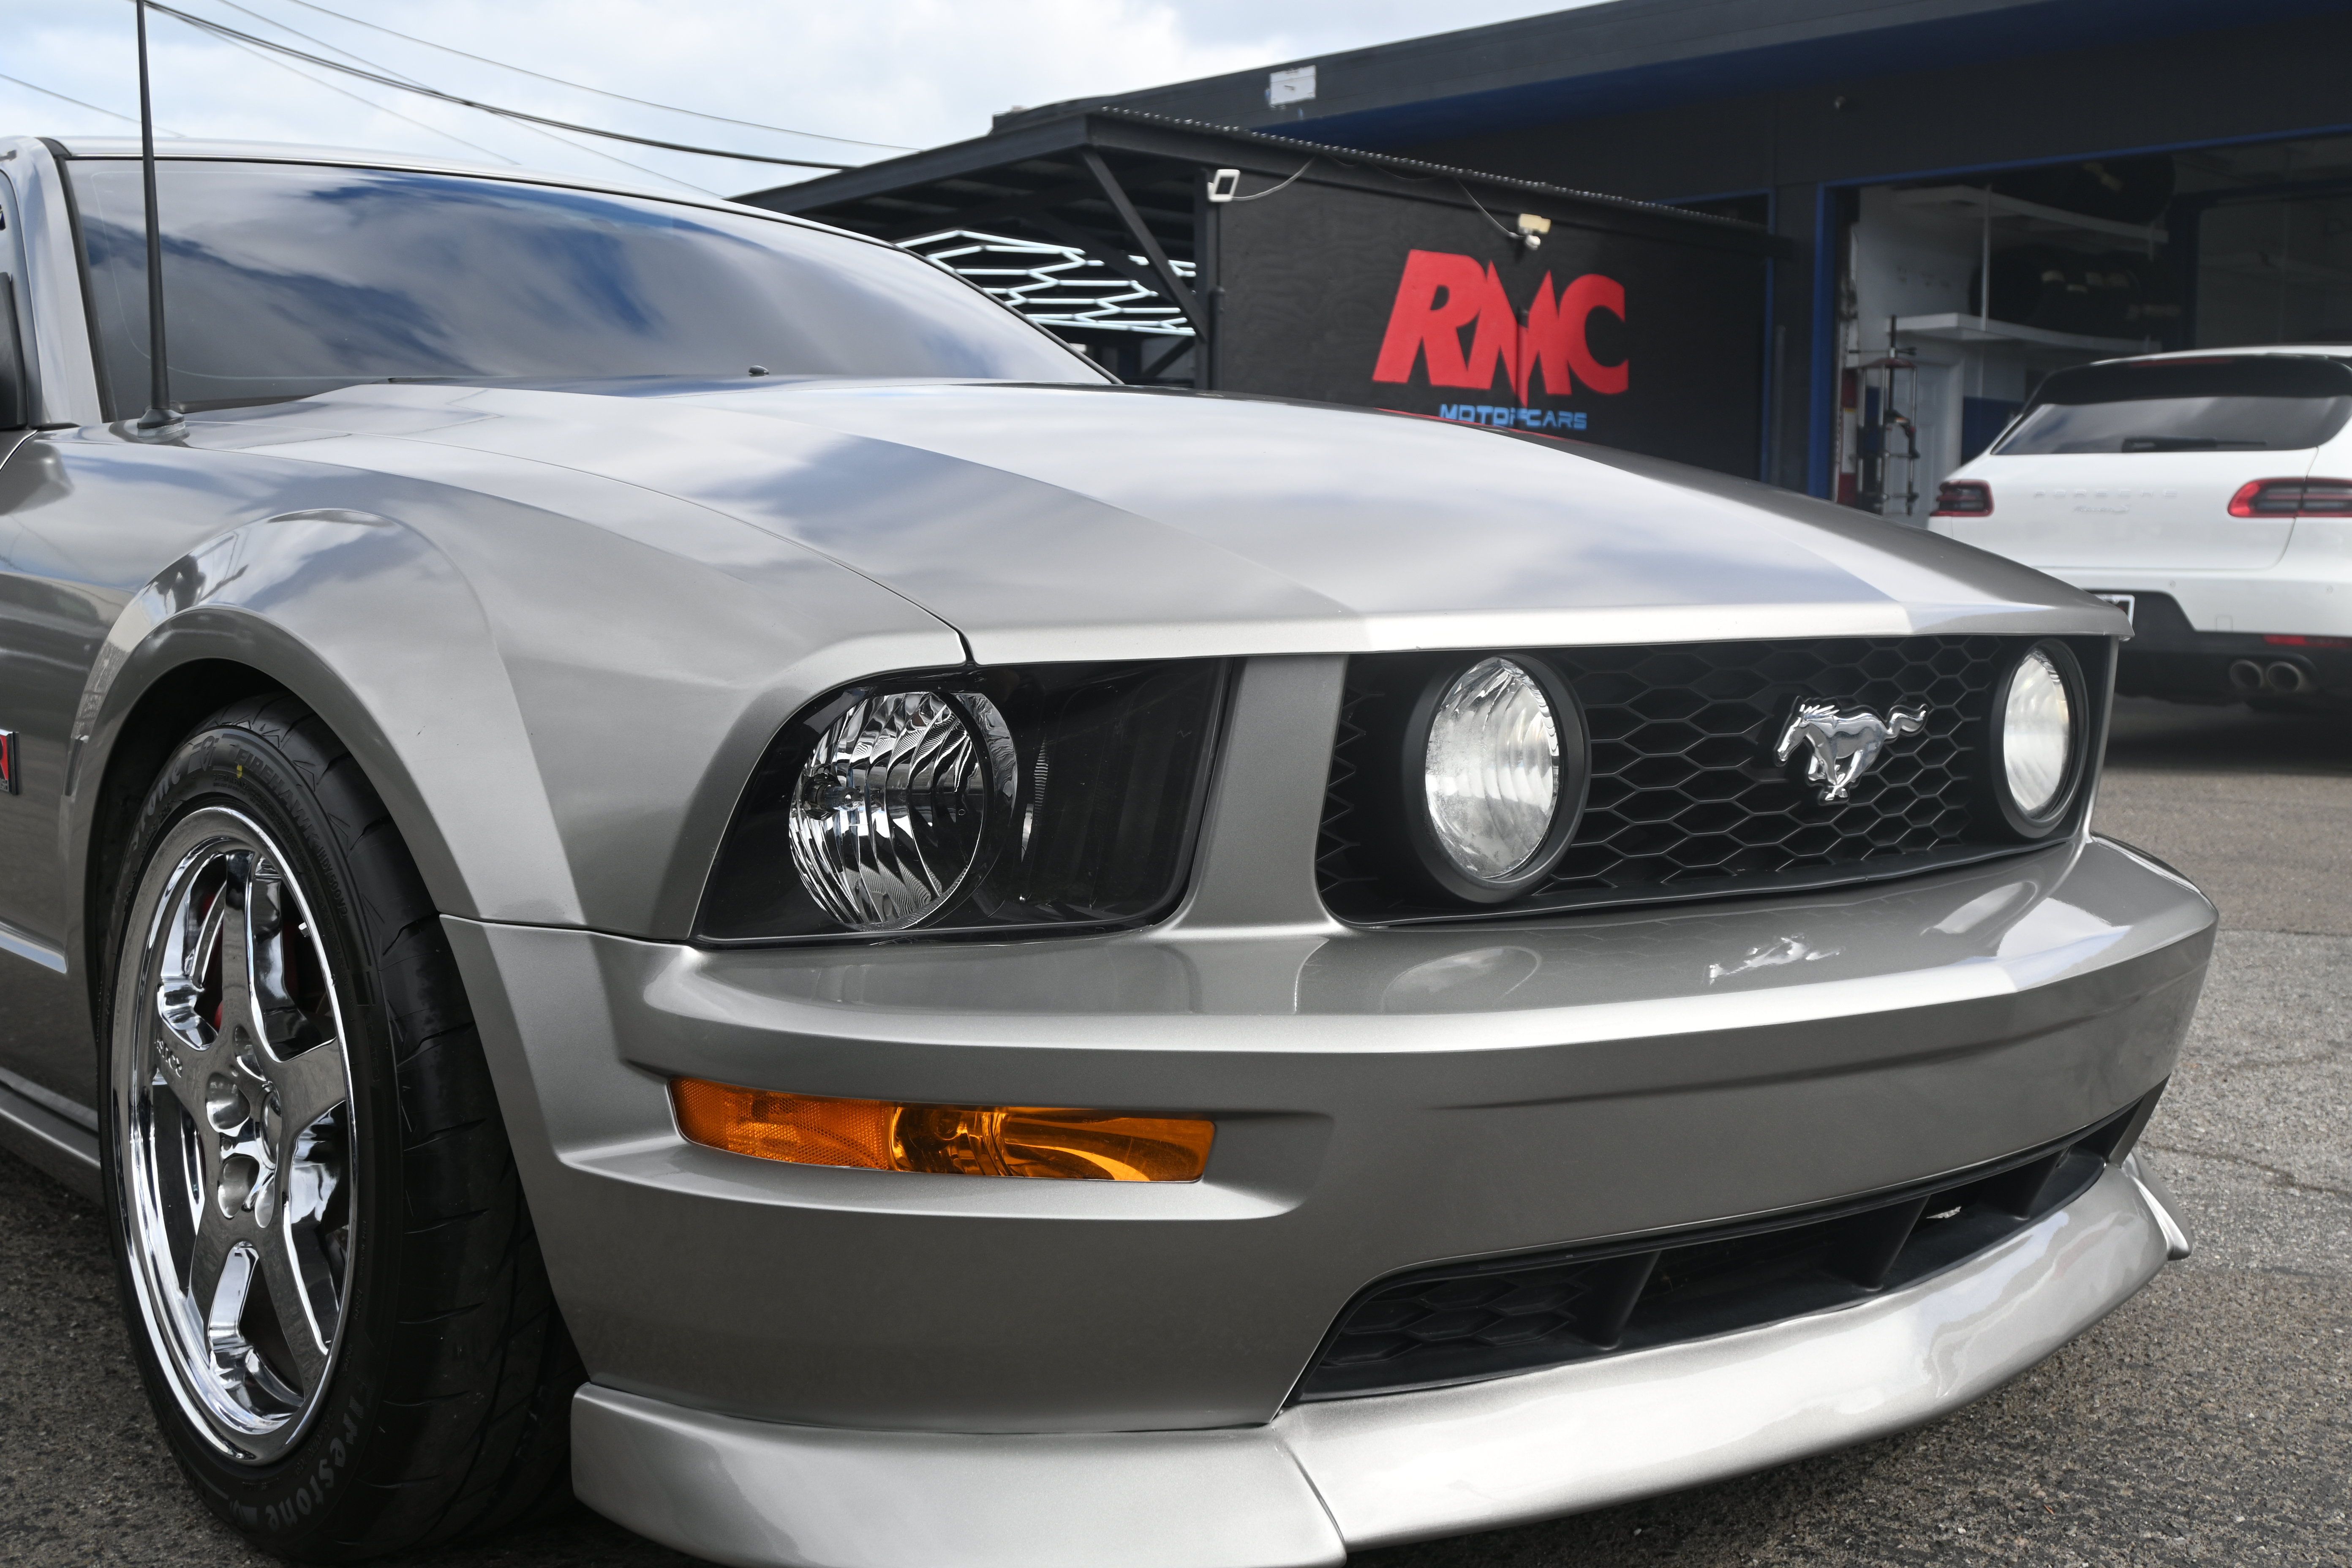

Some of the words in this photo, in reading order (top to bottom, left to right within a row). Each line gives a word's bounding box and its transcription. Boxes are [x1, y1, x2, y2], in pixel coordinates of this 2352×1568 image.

[1372, 249, 1628, 407] RMC
[2034, 489, 2177, 498] PORSCHE
[235, 749, 319, 846] FIREHAWK
